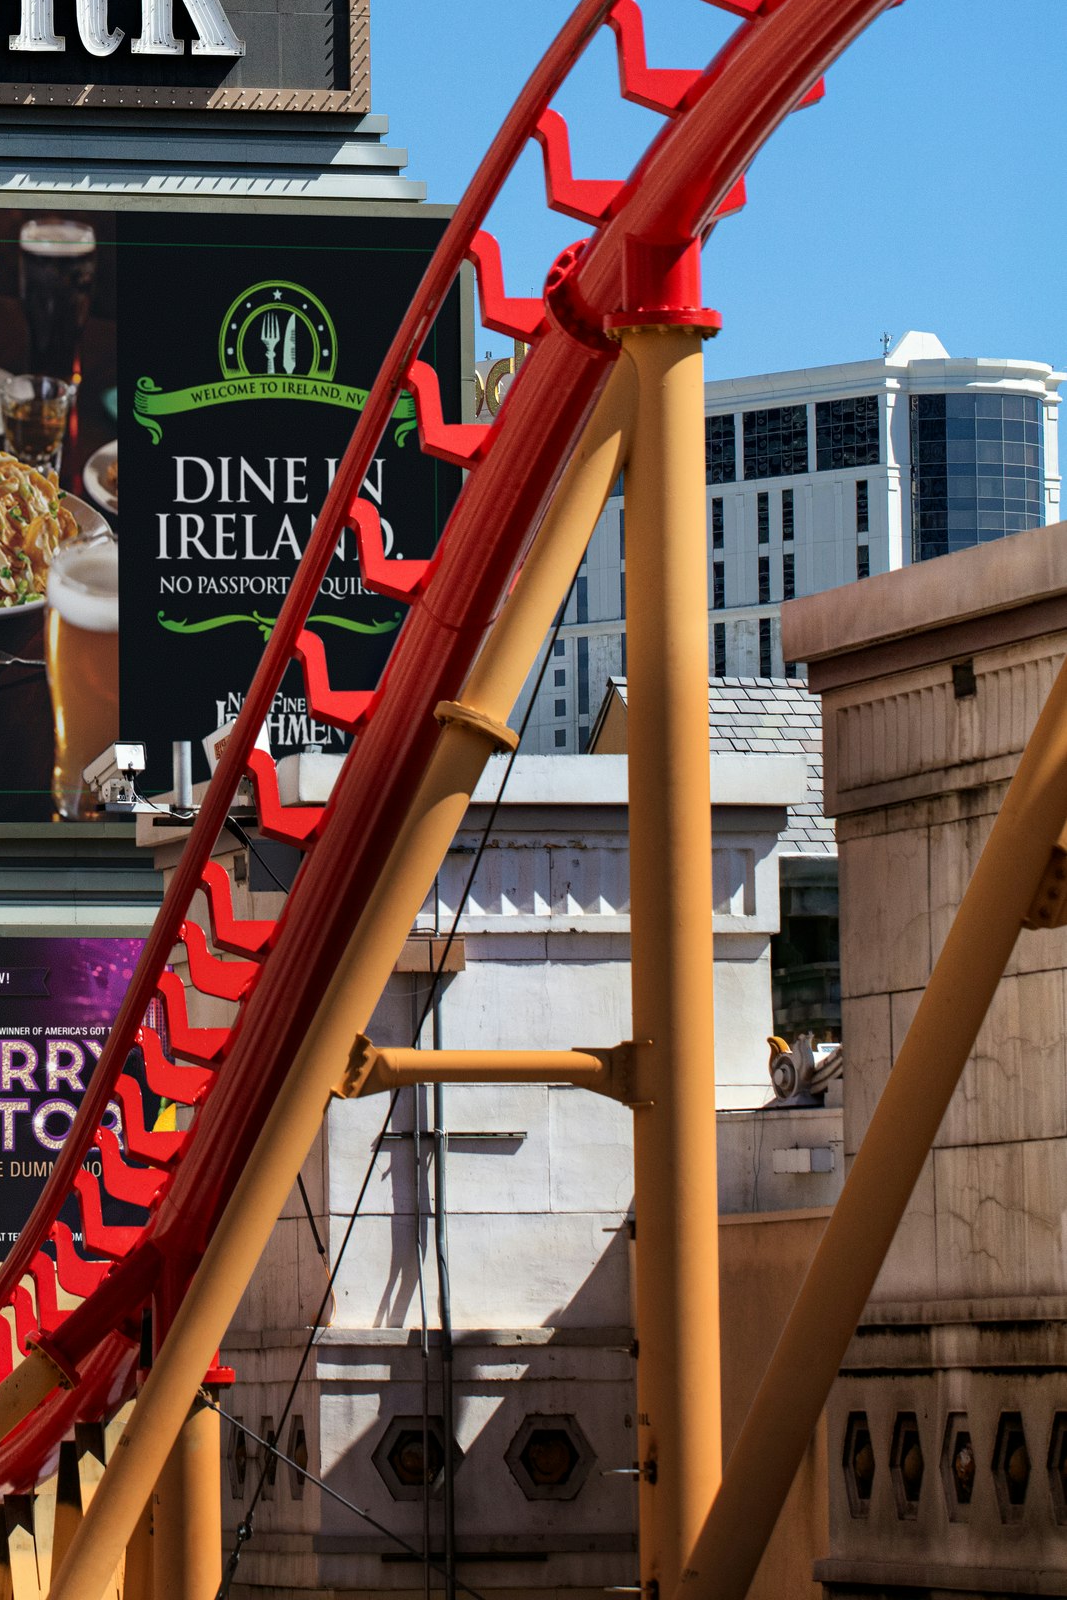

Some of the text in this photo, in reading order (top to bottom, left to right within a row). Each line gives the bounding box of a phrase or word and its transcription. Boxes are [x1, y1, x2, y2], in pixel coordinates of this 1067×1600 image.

[190, 381, 366, 405] WELCOME TO IRELAND, NV
[172, 455, 309, 504] DINE
[159, 576, 192, 594] NO
[197, 576, 291, 594] PASSPORT
[270, 692, 307, 713] FINE
[32, 1027, 42, 1035] OF
[45, 1027, 87, 1035] AMERICA'S
[90, 1027, 105, 1035] GOT
